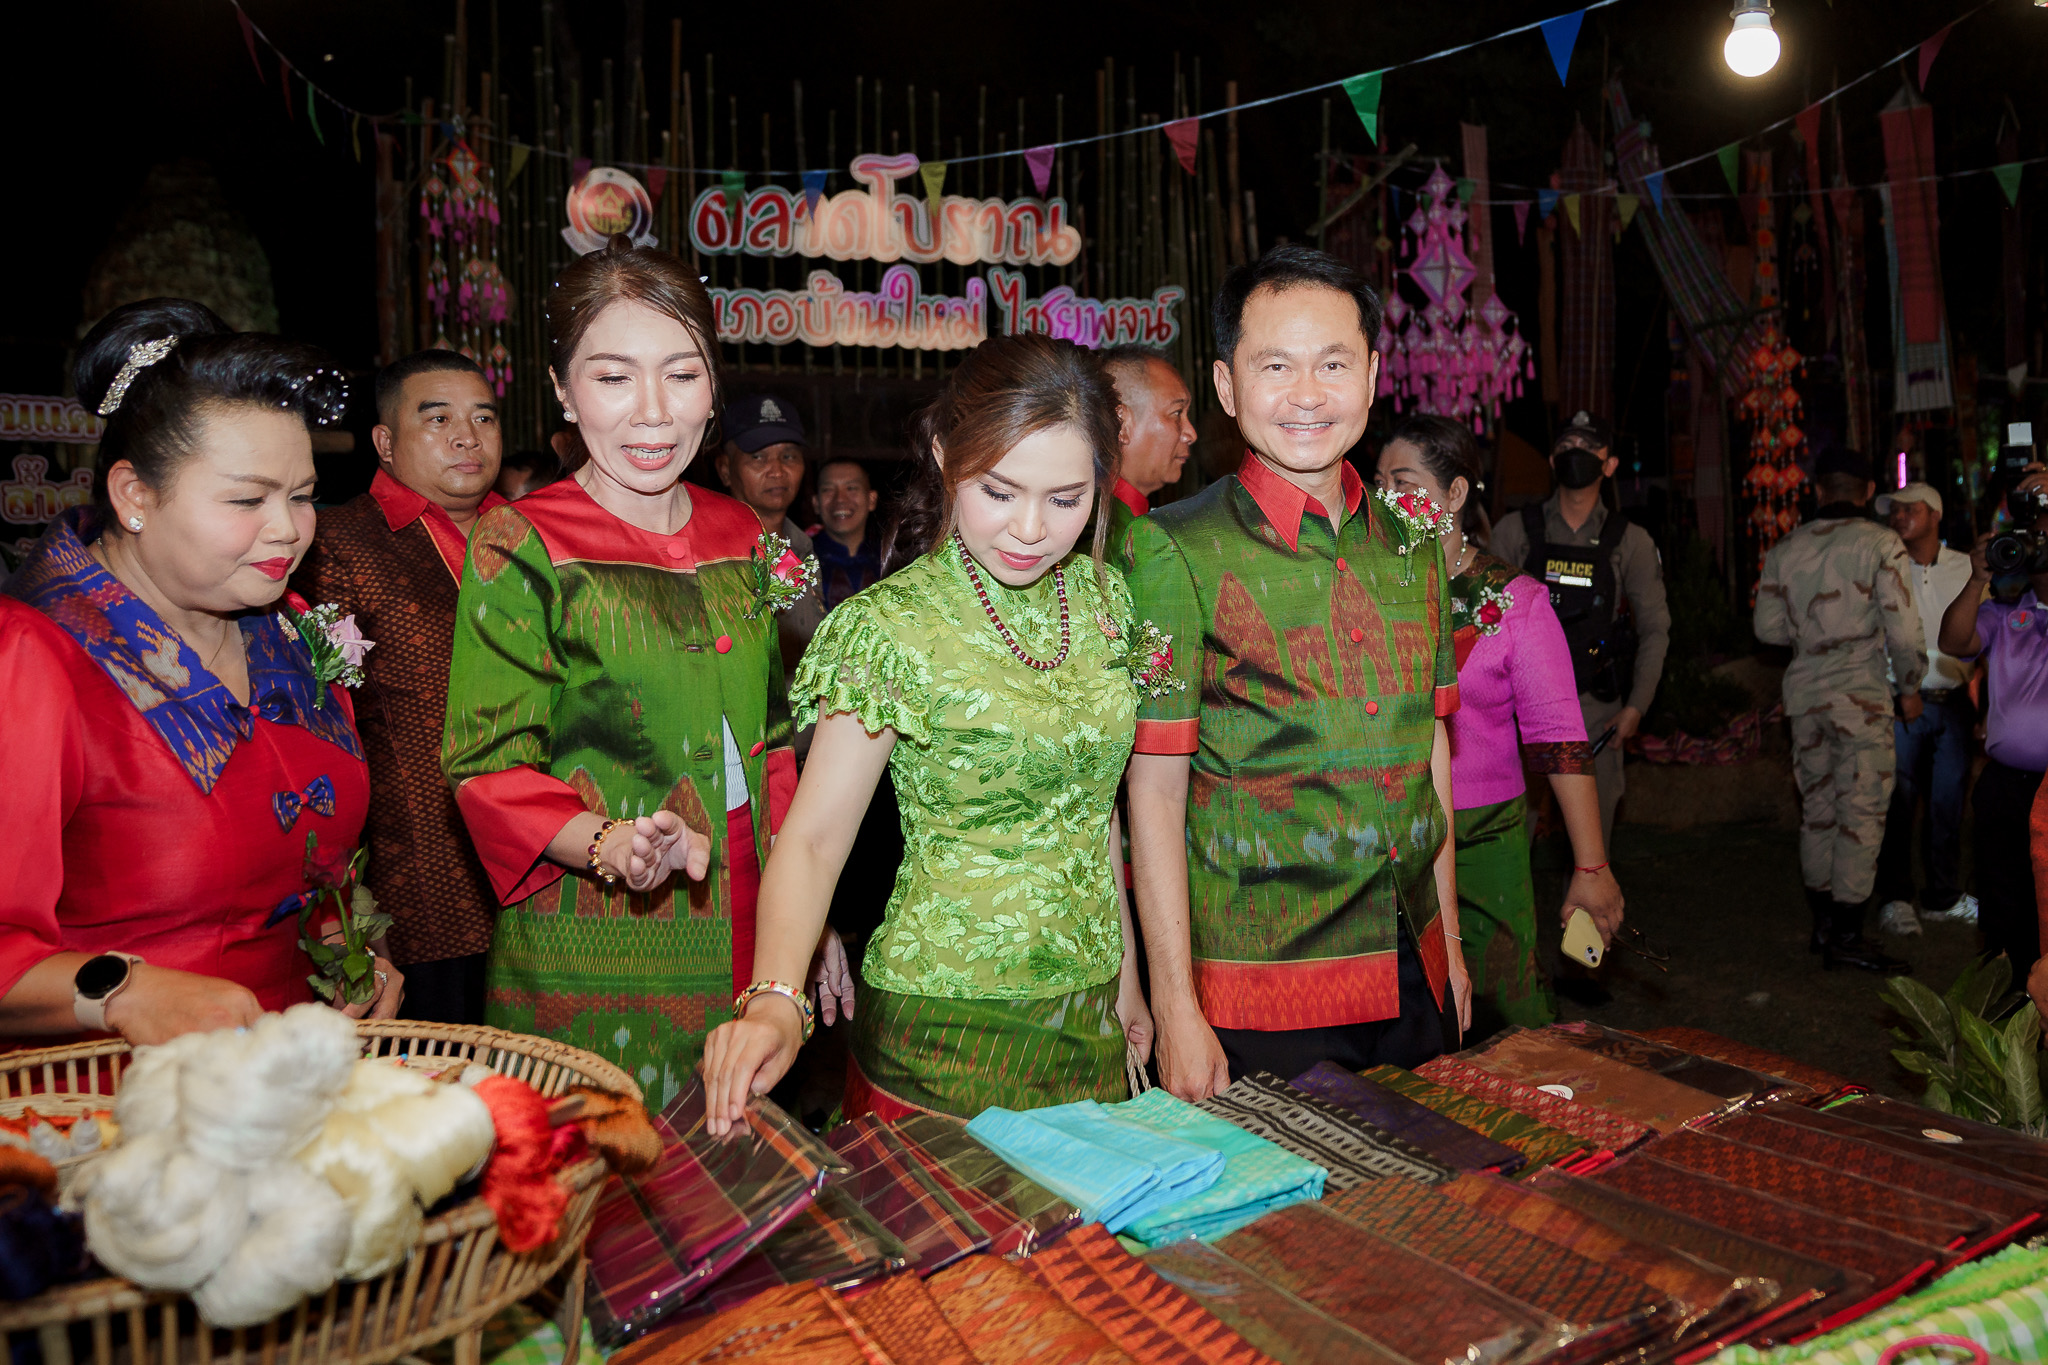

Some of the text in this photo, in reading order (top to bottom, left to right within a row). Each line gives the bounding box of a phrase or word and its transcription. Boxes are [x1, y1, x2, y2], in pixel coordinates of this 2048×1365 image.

[694, 157, 1079, 261] ตลาดโบราณ
[1546, 560, 1593, 577] POLICE
